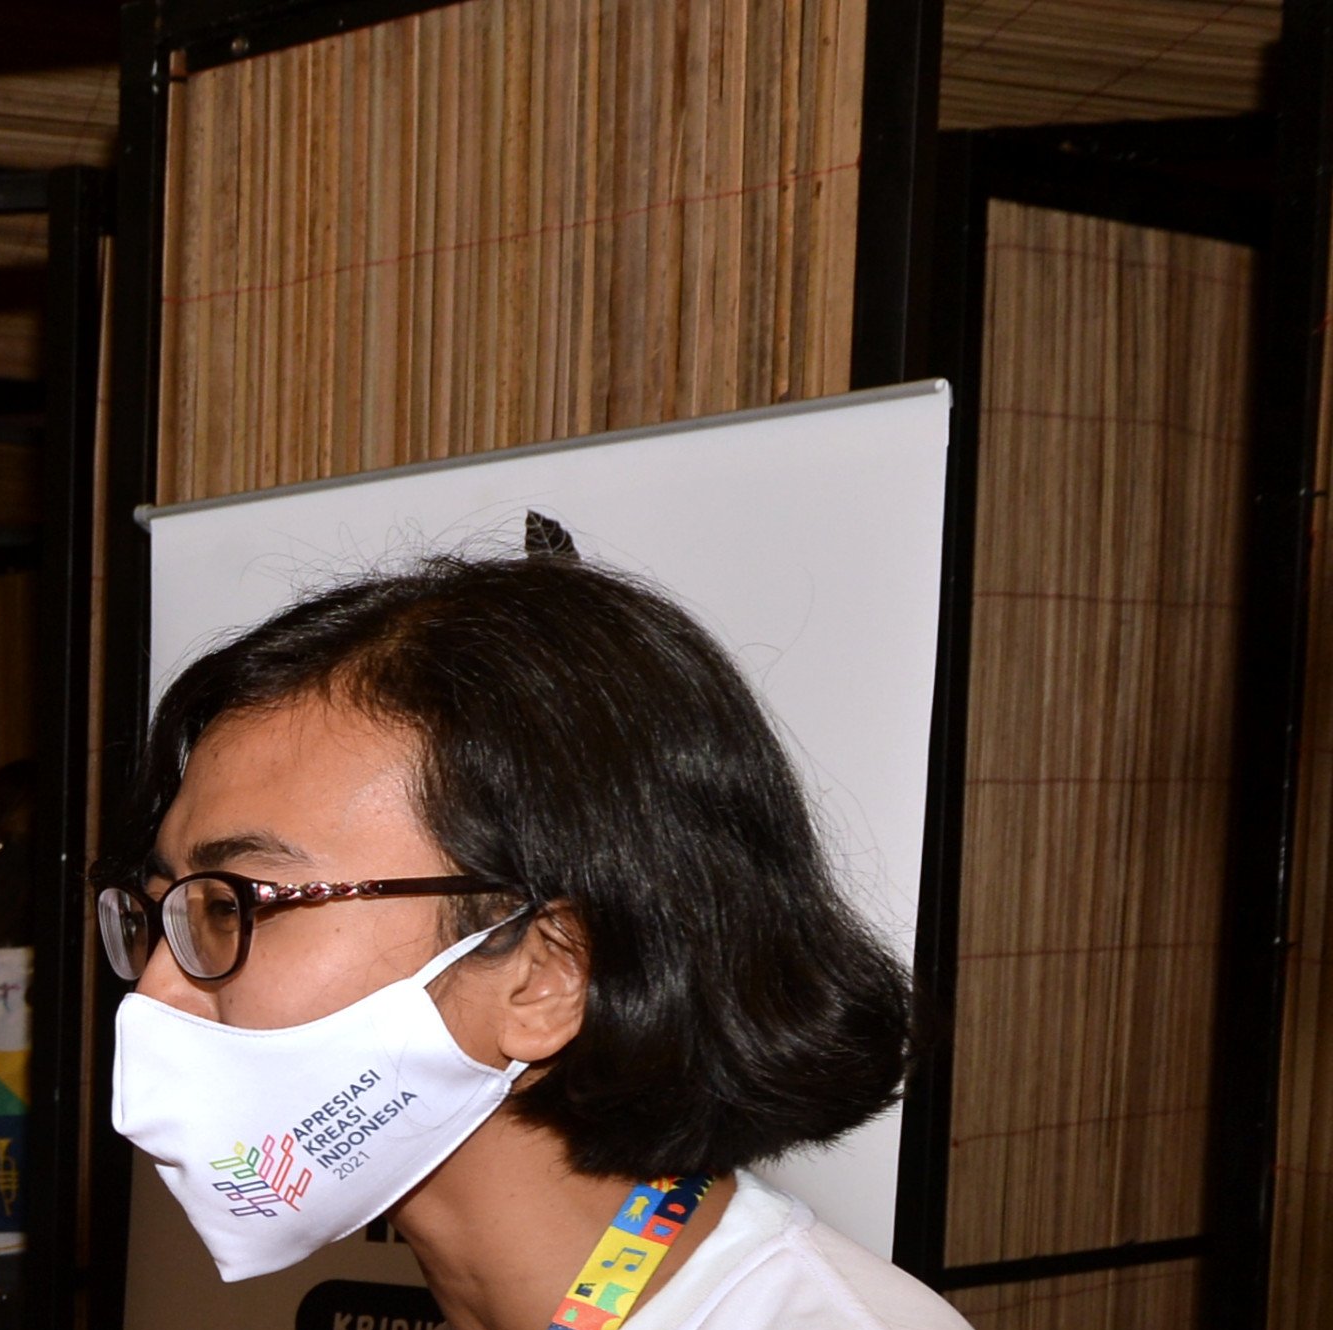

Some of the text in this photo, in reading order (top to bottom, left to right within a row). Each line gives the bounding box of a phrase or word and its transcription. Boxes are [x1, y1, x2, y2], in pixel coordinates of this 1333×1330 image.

[292, 1069, 382, 1143] APRESIASI
[301, 1105, 368, 1157] KREASI
[316, 1090, 418, 1171] INDONESIA
[332, 1150, 372, 1181] 2021
